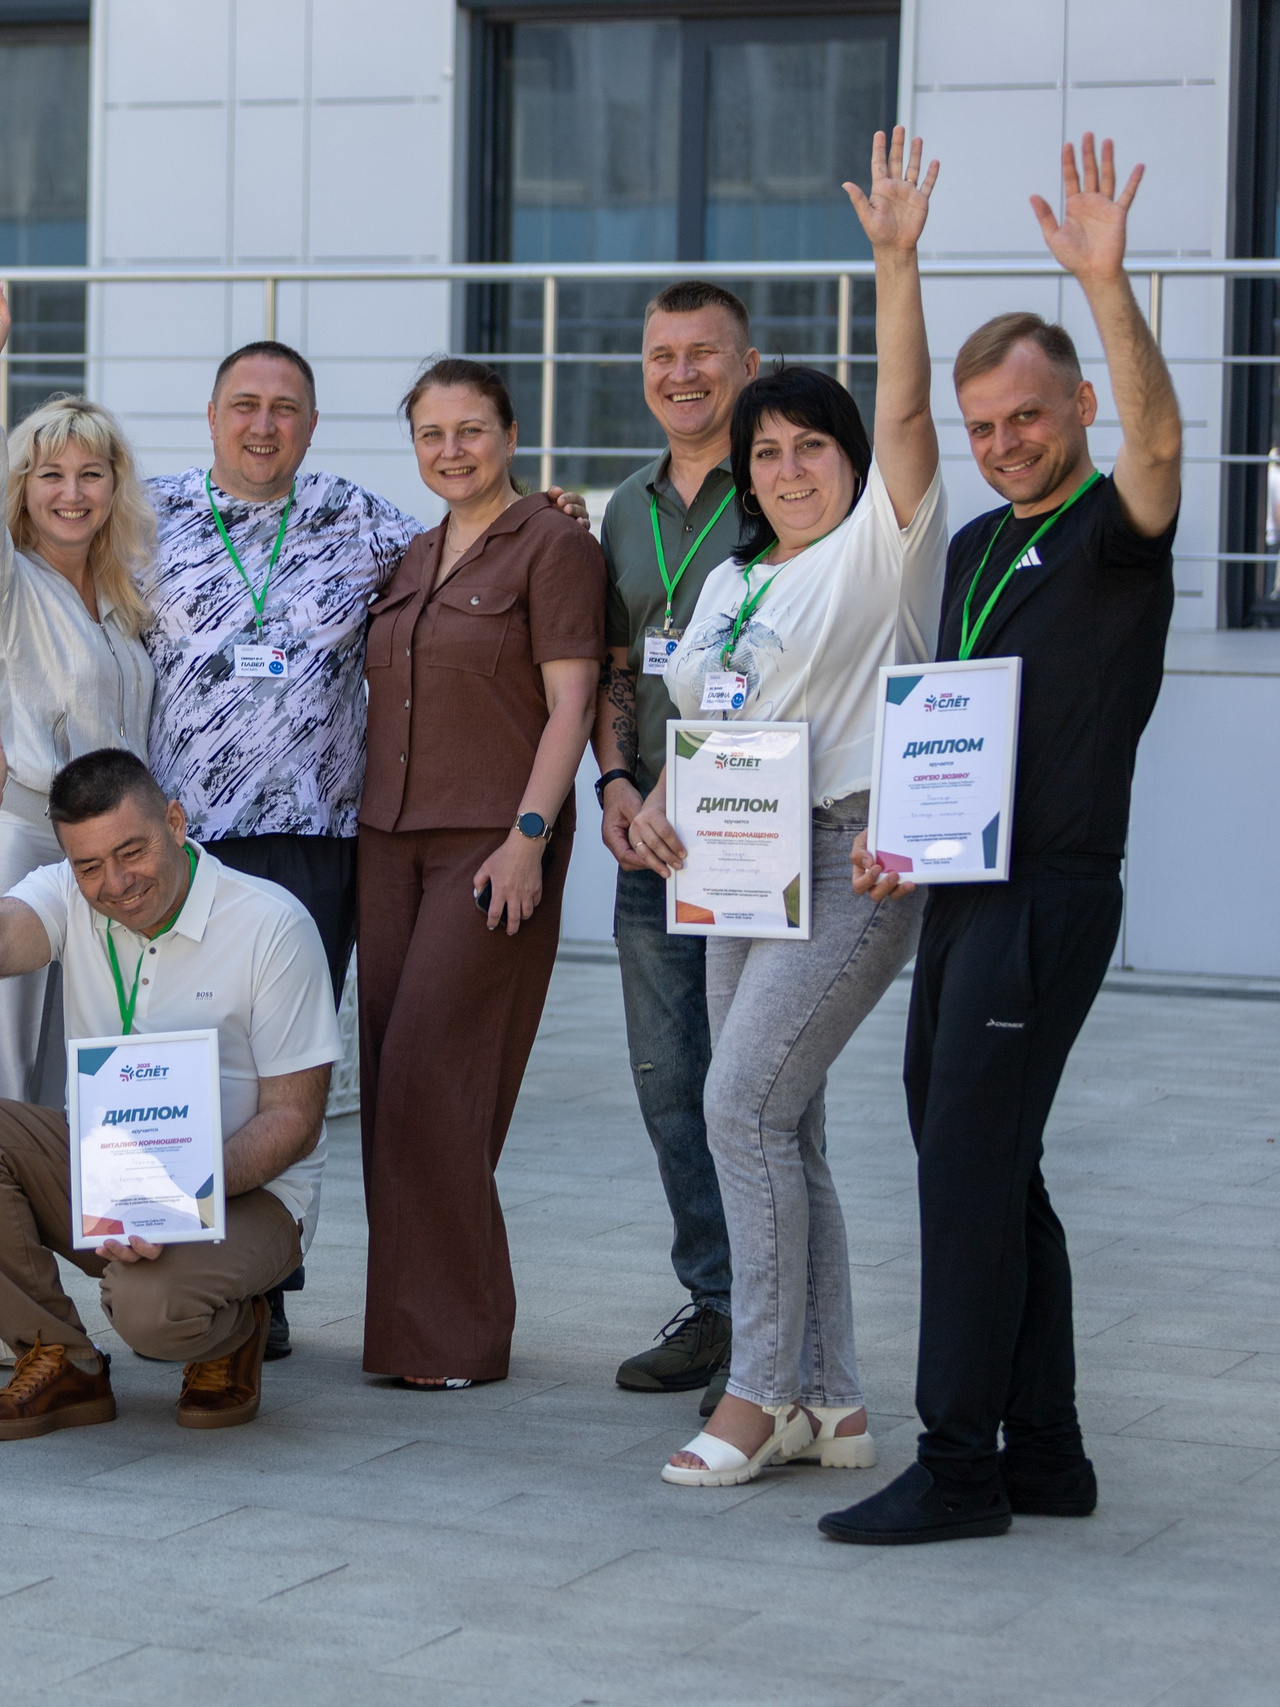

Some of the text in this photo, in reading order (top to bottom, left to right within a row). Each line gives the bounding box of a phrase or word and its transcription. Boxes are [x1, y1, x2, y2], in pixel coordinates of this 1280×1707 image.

[938, 696, 970, 709] СЛЁТ
[902, 738, 984, 759] ДИПЛОМ
[729, 756, 761, 768] СЛЁТ
[913, 774, 940, 782] СЕРГЕЮ
[696, 797, 779, 813] ДИПЛОМ
[724, 831, 779, 839] ЕВДОМАЩЕНКО
[135, 1065, 169, 1078] СЛЁТ
[102, 1105, 189, 1127] ДИПЛОМ
[100, 1137, 192, 1149] ВИТАЛИЮ КОРНЮШЕНКО
